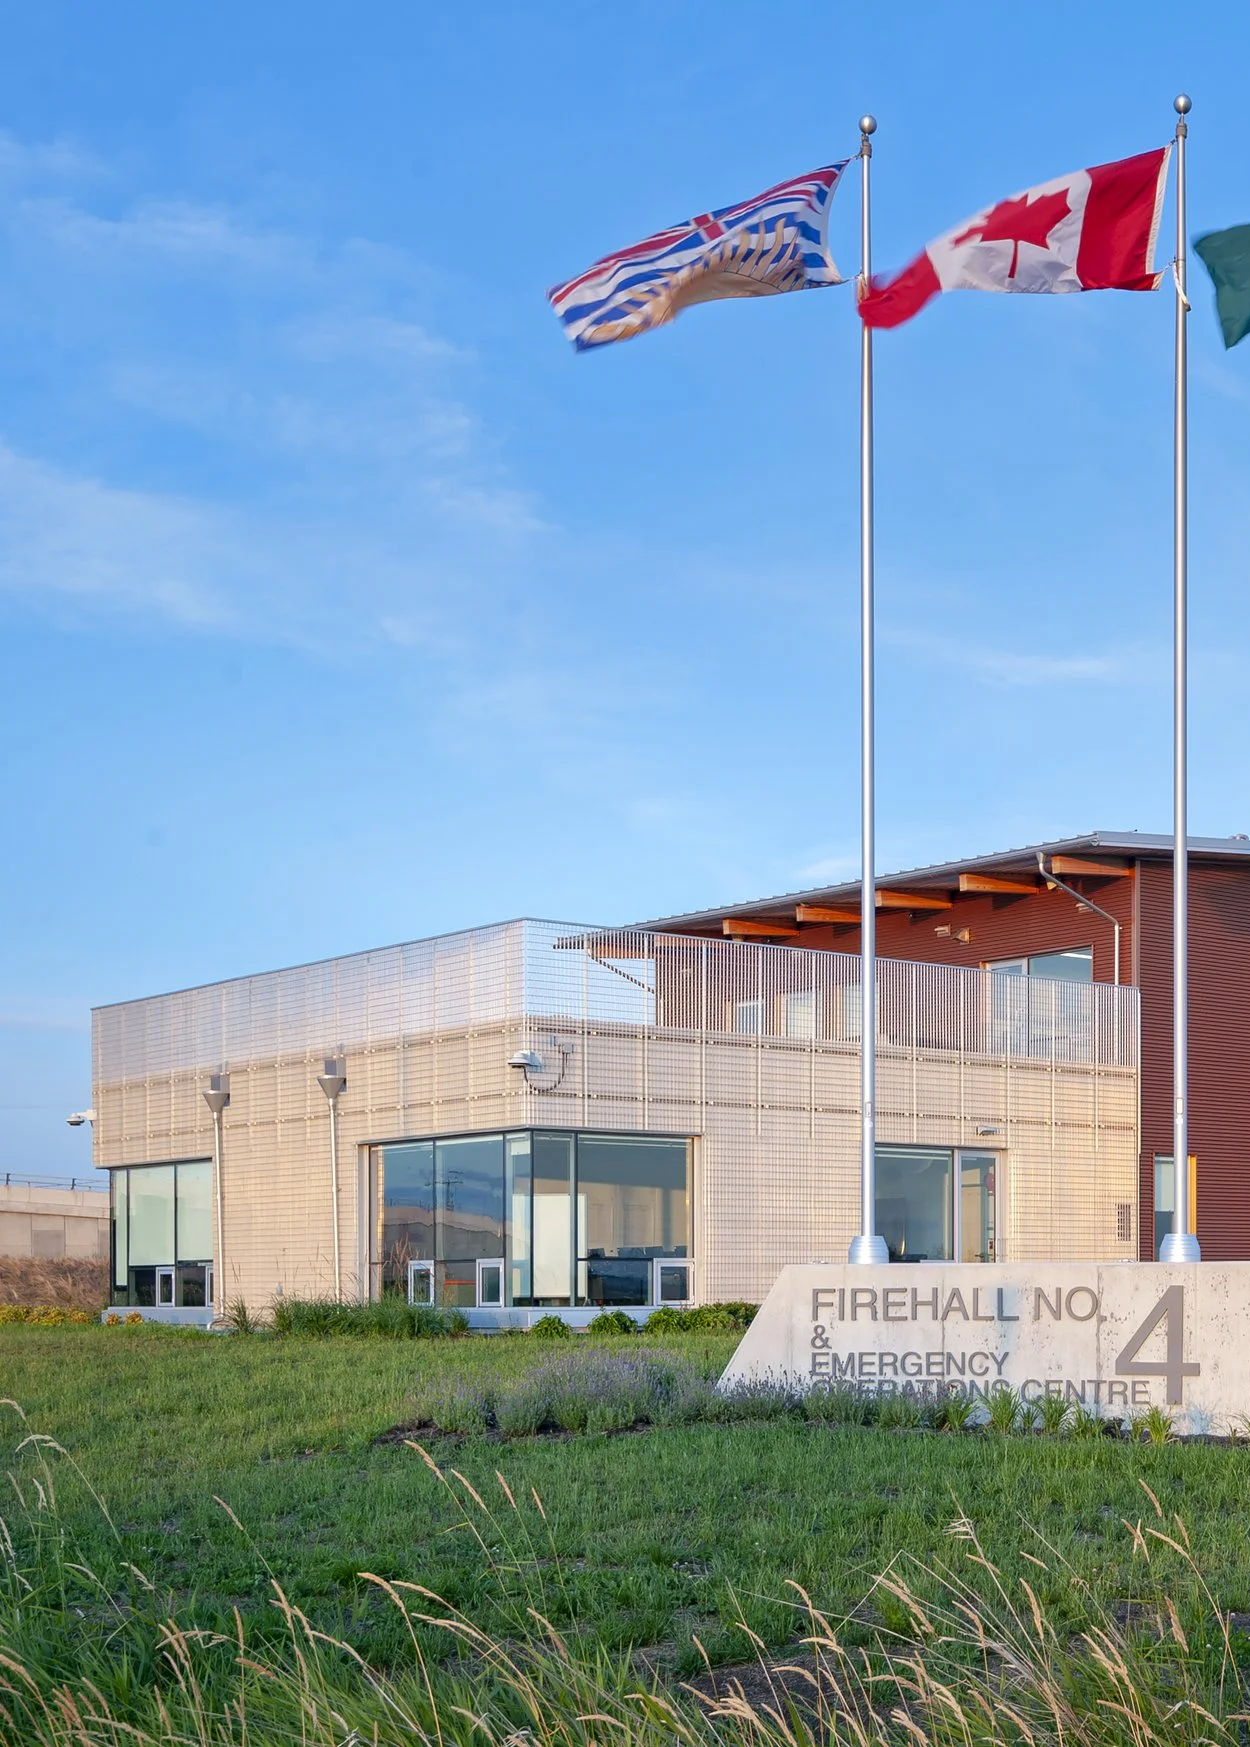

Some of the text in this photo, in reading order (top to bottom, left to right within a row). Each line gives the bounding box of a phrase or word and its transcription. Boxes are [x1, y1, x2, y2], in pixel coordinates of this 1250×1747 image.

[811, 1325, 832, 1349] &
[811, 1285, 1200, 1405] FIREHALL NO. 4
[811, 1351, 1009, 1376] EMERGENCY
[1020, 1379, 1150, 1404] CENTRE
